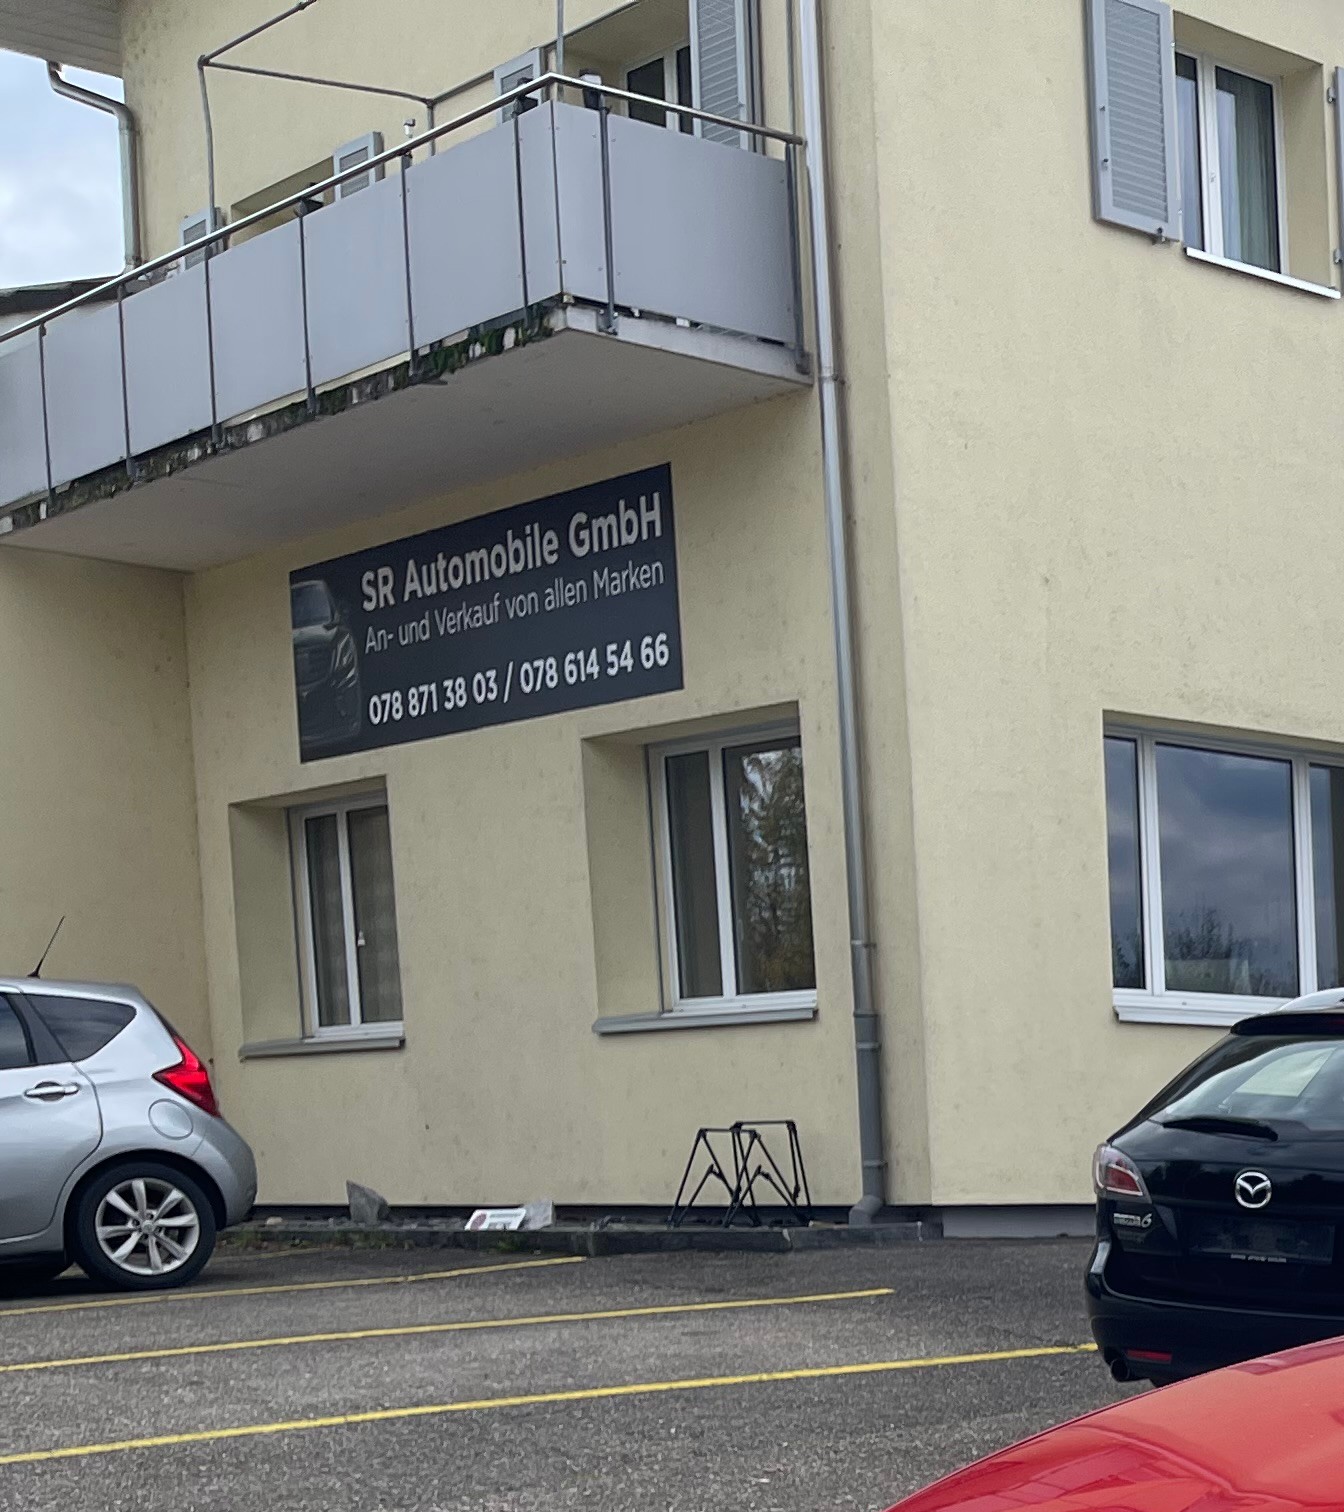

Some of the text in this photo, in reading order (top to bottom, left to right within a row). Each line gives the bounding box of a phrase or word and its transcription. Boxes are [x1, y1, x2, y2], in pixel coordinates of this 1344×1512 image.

[361, 492, 662, 612] SR Automobile GmbH
[365, 559, 664, 654] An- und Verkauf von allen Marken
[369, 632, 669, 726] 078 871 38 03 / 078 614 54 66
